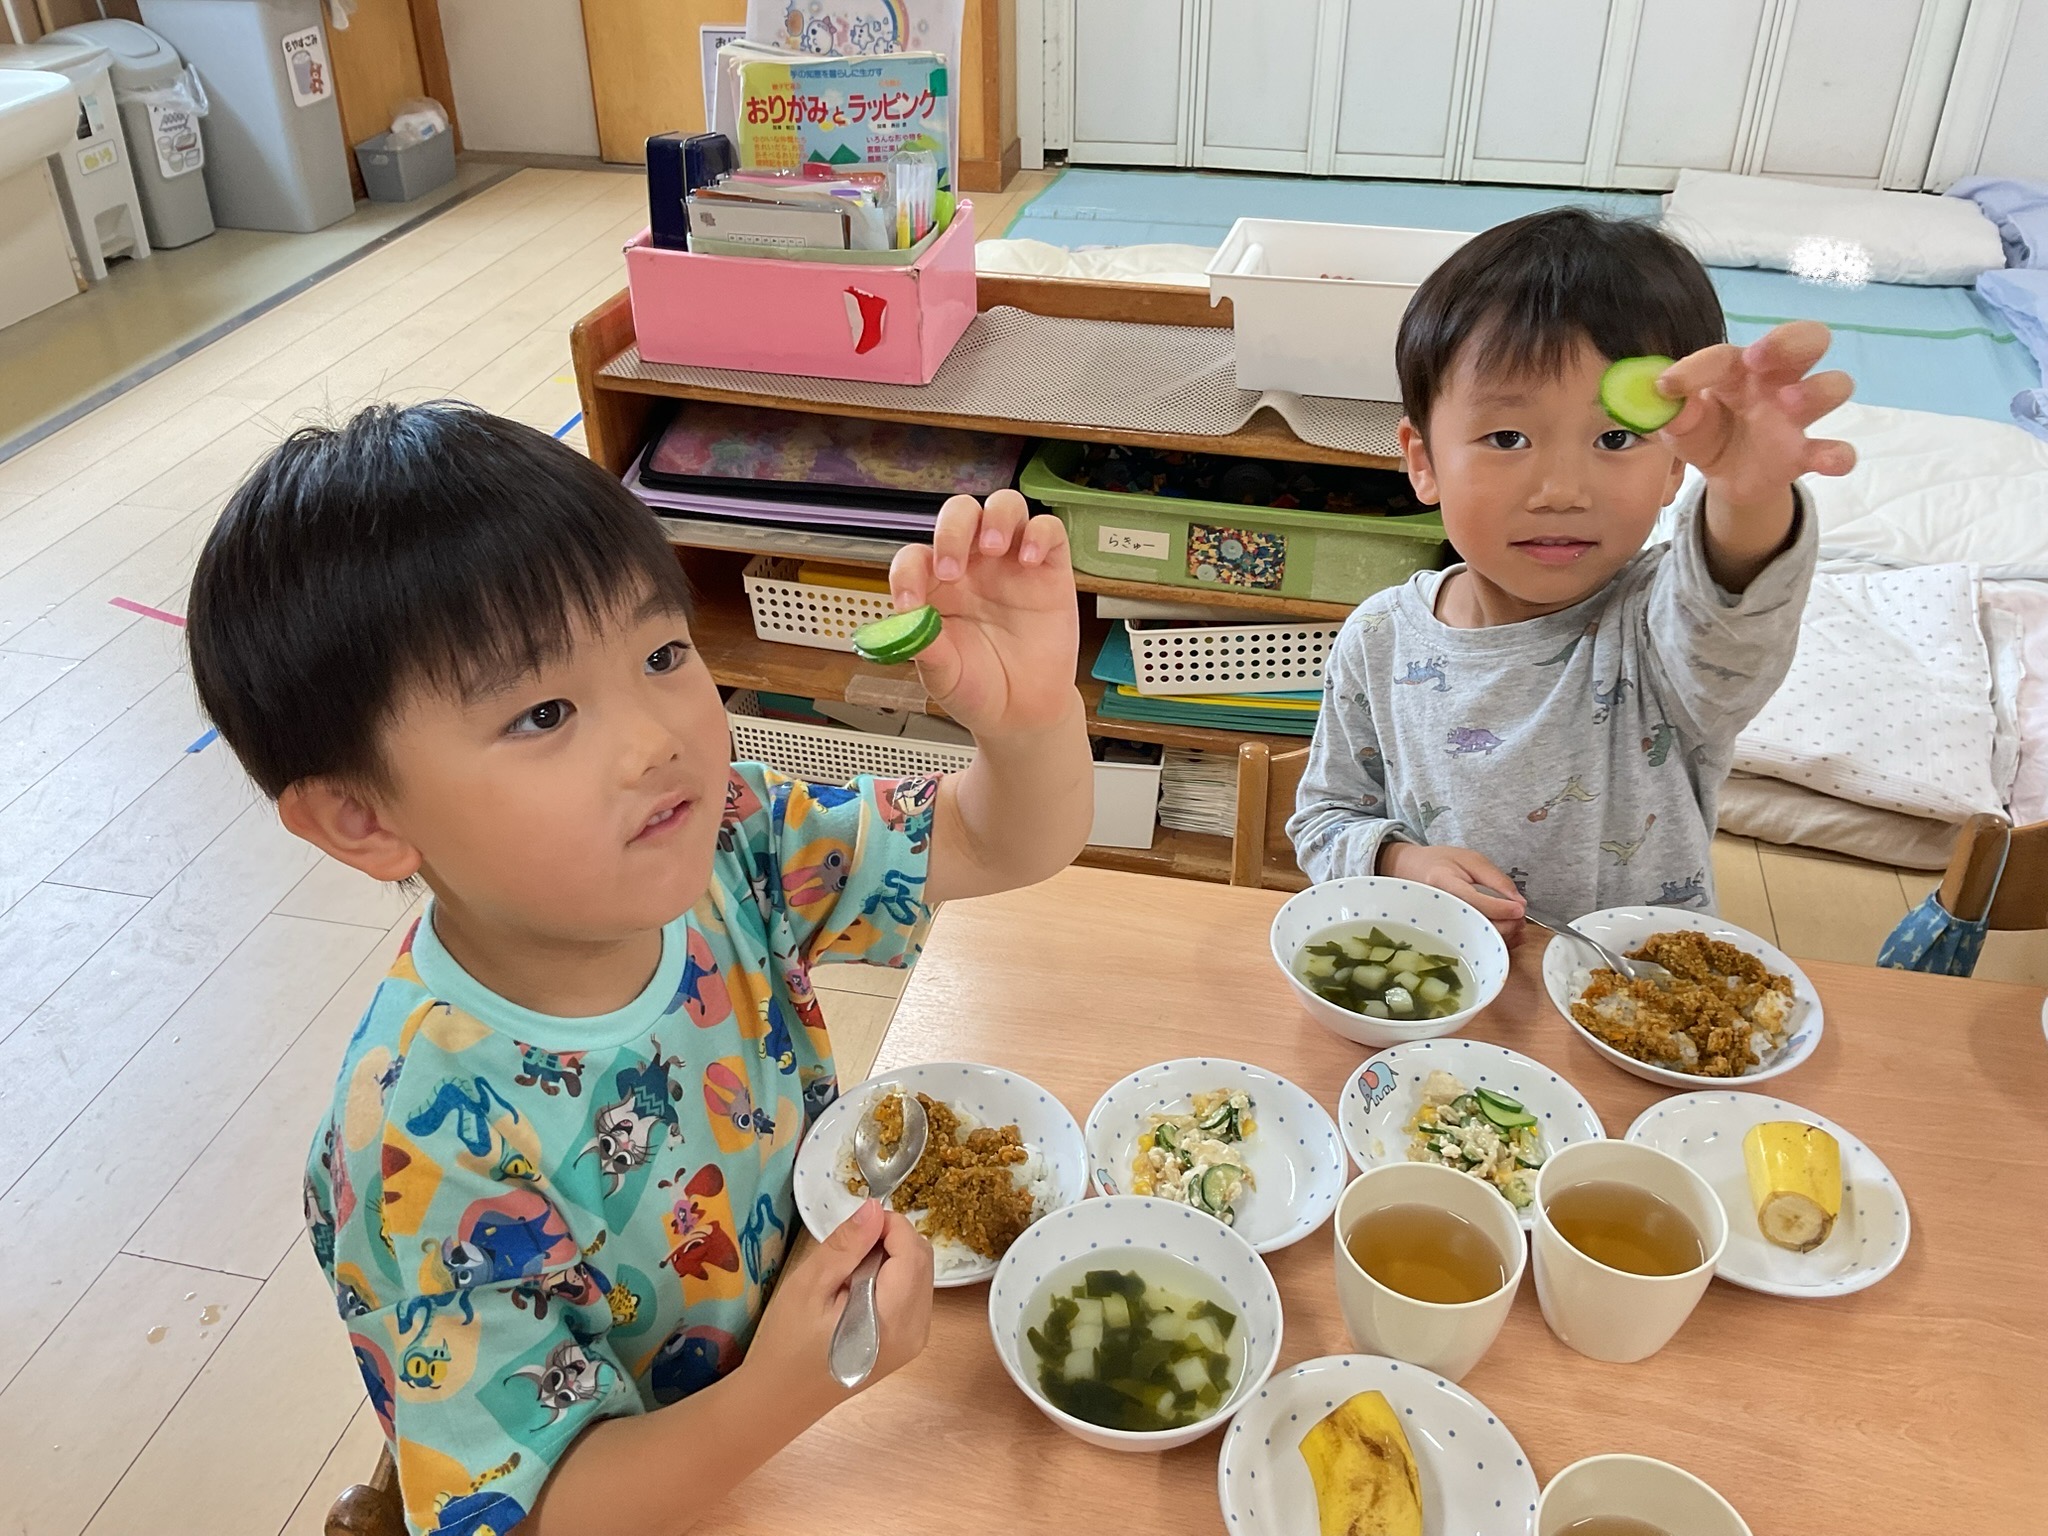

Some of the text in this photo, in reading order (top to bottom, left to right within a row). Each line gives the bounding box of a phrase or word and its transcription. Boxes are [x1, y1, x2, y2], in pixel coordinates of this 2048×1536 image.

[746, 89, 936, 126] おりがみとラッピング
[1109, 533, 1155, 550] らきゅー
